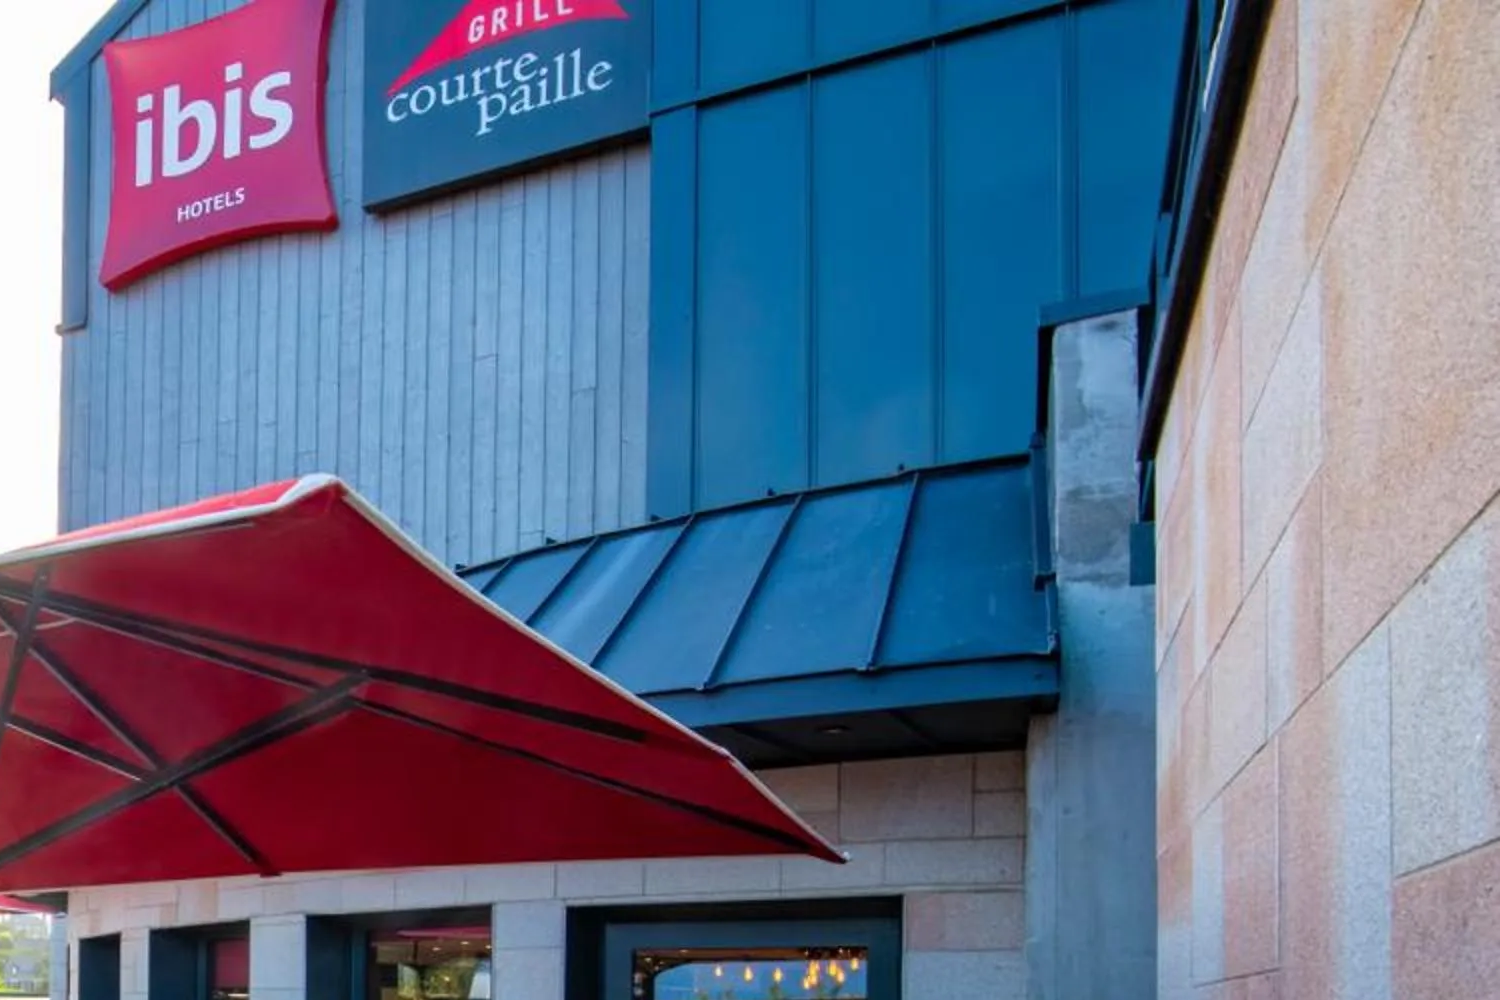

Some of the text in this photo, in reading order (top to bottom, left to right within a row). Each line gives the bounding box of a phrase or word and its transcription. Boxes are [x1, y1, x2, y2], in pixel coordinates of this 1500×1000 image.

[468, 0, 573, 44] GRILL
[387, 52, 539, 122] courte
[475, 47, 613, 136] paille
[134, 62, 294, 187] ibis
[177, 187, 245, 223] HOTELS
